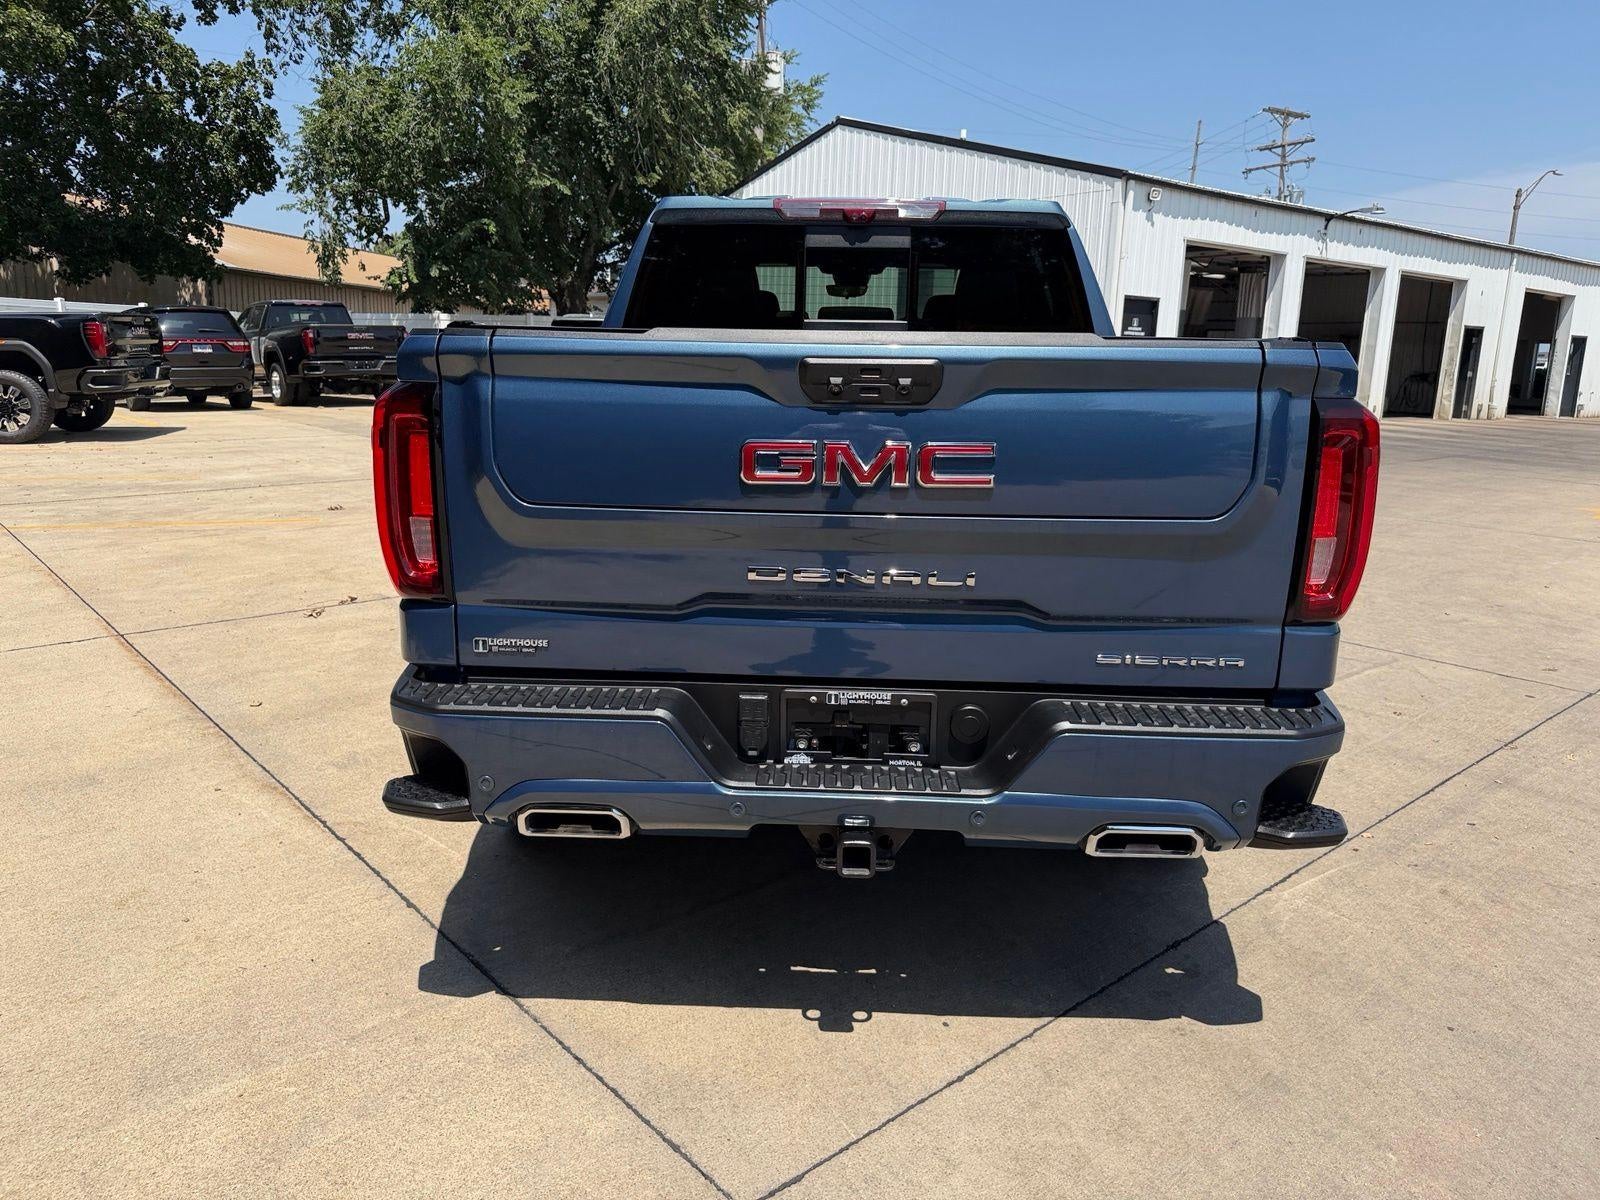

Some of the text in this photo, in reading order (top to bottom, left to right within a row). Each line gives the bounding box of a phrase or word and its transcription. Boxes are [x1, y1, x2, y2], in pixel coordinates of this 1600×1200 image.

[740, 439, 997, 488] GMC
[747, 566, 976, 587] DENALI
[488, 637, 549, 648] LIGHTHOUSE
[1095, 654, 1245, 667] SIERRA
[840, 691, 892, 700] LIGHTHOUSE
